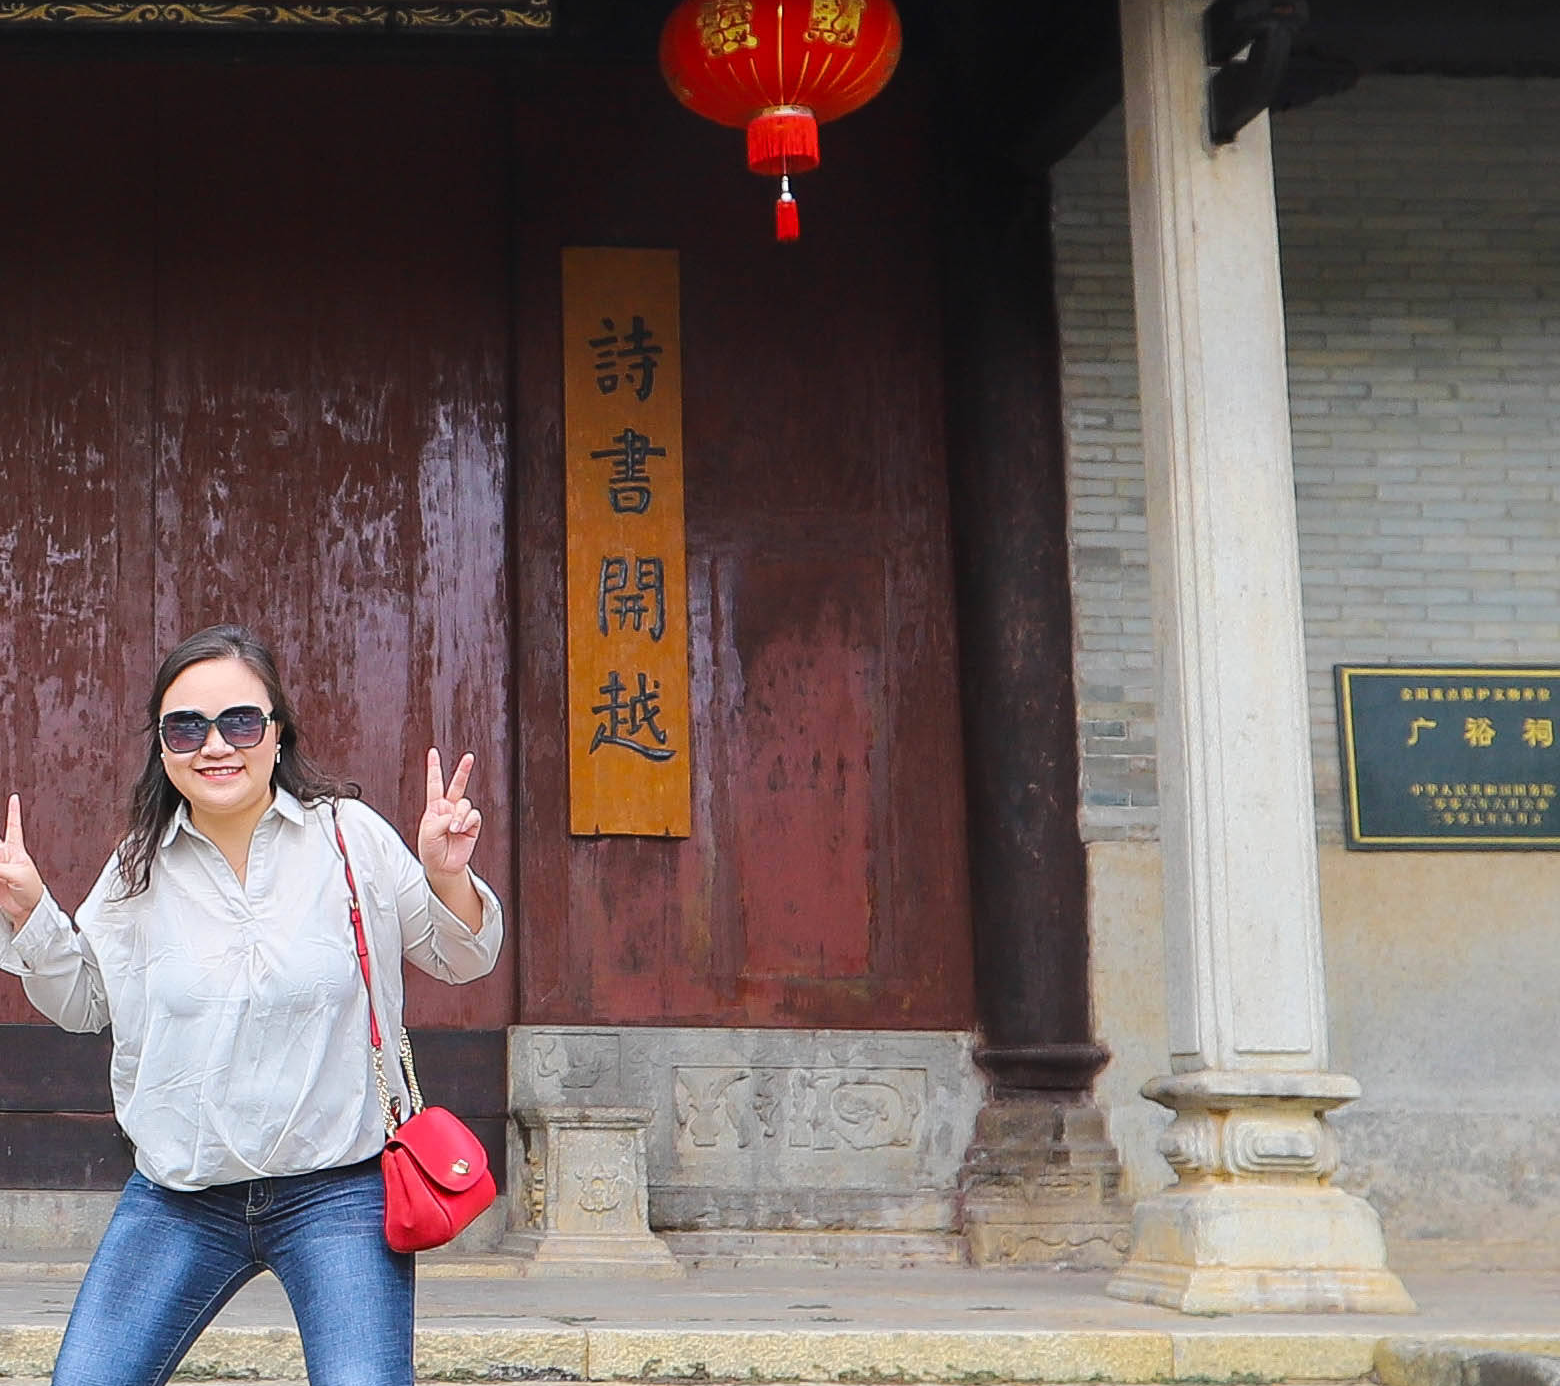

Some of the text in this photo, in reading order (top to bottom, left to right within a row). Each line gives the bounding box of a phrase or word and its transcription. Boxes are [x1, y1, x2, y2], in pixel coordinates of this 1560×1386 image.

[588, 316, 677, 762] 詩書開越
[1406, 716, 1554, 747] 广裕祠
